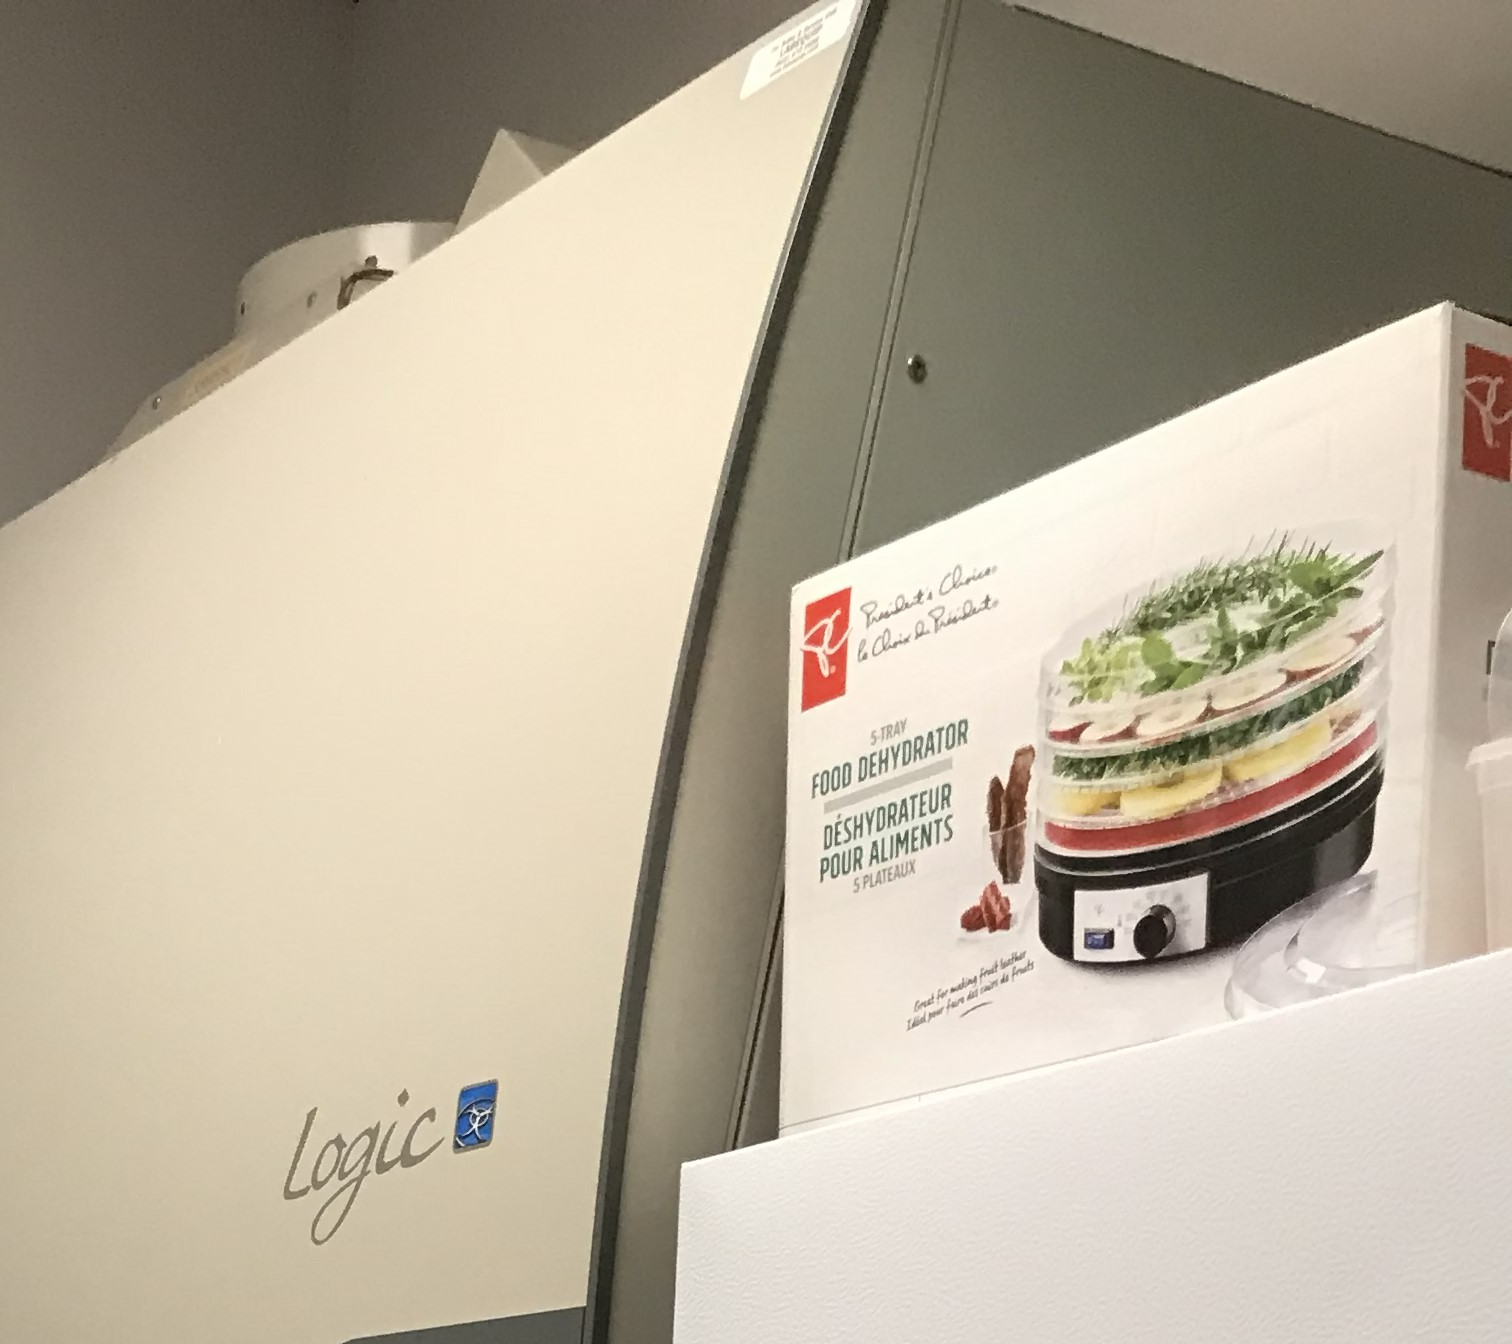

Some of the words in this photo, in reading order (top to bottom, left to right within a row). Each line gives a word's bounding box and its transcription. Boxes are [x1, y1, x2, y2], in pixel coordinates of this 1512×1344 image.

[811, 761, 852, 799] FOOD
[858, 718, 969, 783] DEHYDRATOR
[871, 717, 907, 746] 5-TRAY
[819, 846, 863, 883] POUR
[868, 814, 953, 866] ALIMENTS
[824, 782, 952, 850] DÉSHYDRATEUR
[853, 877, 860, 893] 5
[863, 859, 916, 890] PLATEAUX
[950, 975, 977, 994] making
[979, 960, 998, 984] fruit
[283, 1088, 445, 1246] Logic
